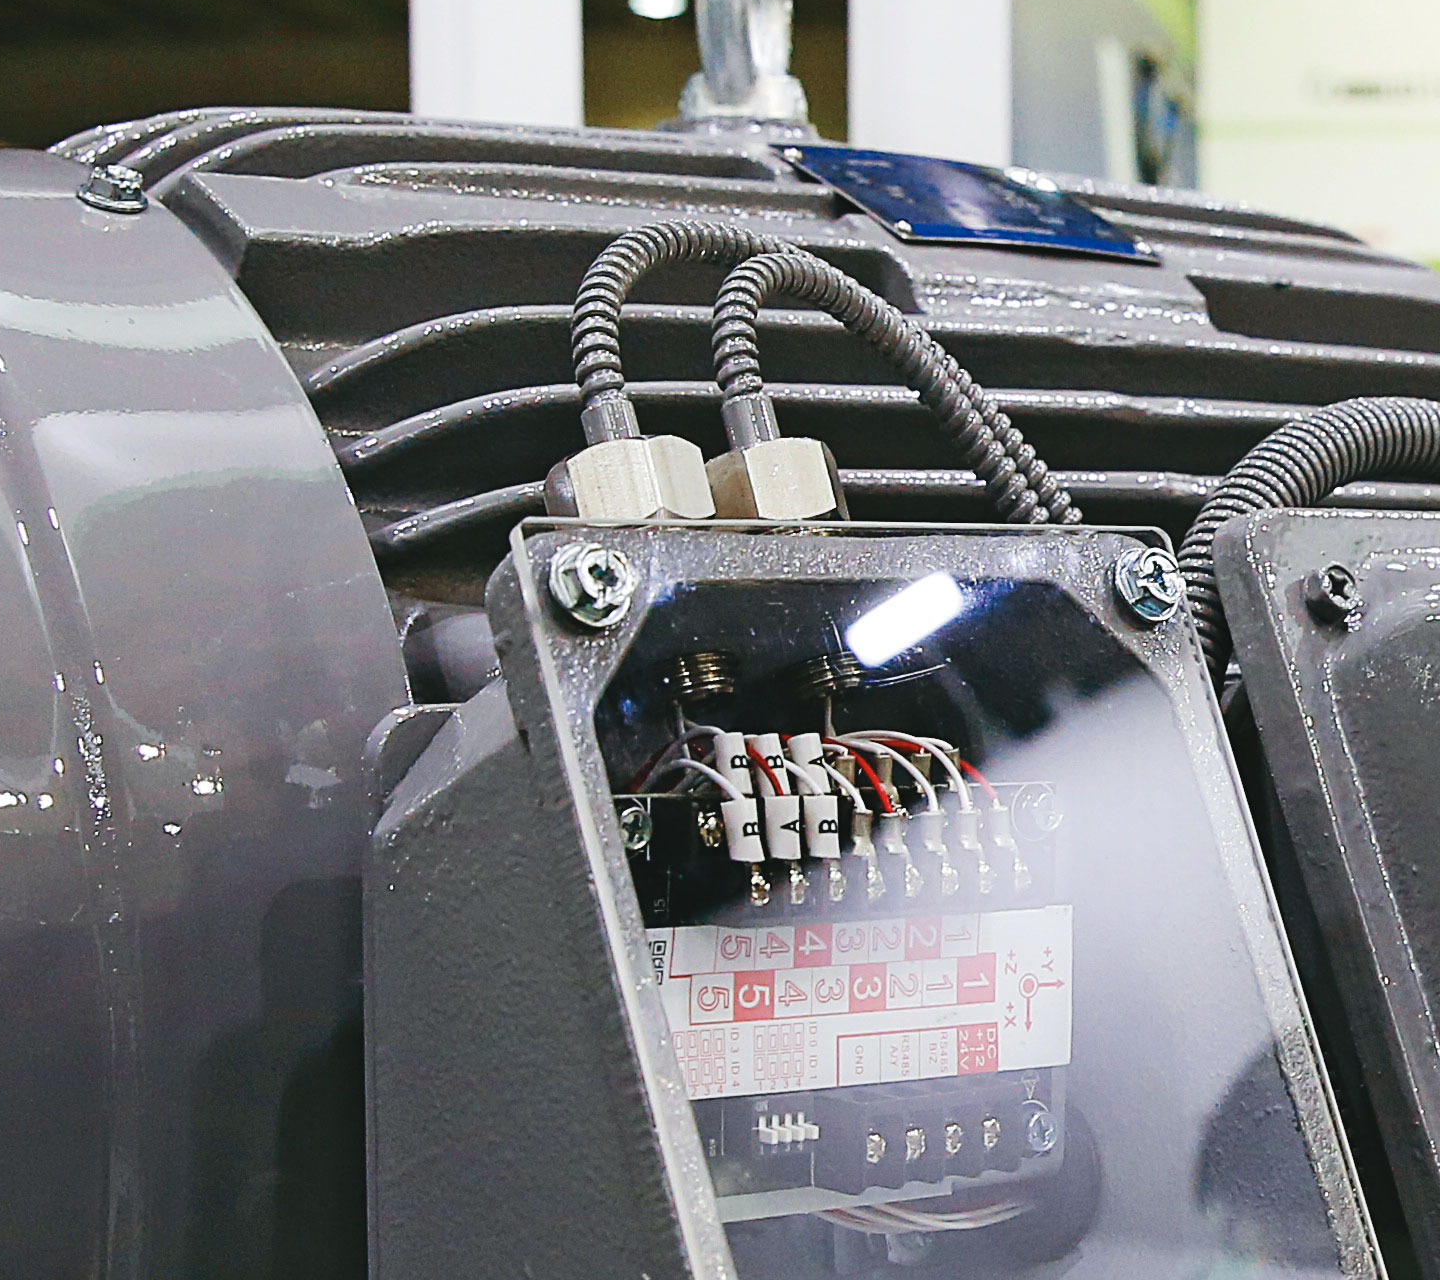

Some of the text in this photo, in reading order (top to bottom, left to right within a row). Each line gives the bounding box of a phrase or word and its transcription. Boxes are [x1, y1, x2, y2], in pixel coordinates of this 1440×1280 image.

[760, 932, 790, 958] 4
[798, 930, 828, 955] 4
[835, 928, 866, 952] 3
[872, 926, 902, 951] 2
[909, 924, 938, 949] 2
[945, 927, 971, 941] 1
[720, 935, 752, 960] 5
[815, 977, 845, 1003] 3
[853, 976, 882, 1000] 3
[889, 973, 919, 998] 2
[926, 974, 953, 991] 1
[963, 972, 990, 988] 1
[697, 986, 729, 1012] 5
[738, 984, 770, 1008] 5
[778, 980, 807, 1007] 4
[959, 1030, 969, 1070] 24V
[986, 1028, 997, 1059] DC
[855, 1044, 864, 1076] GND
